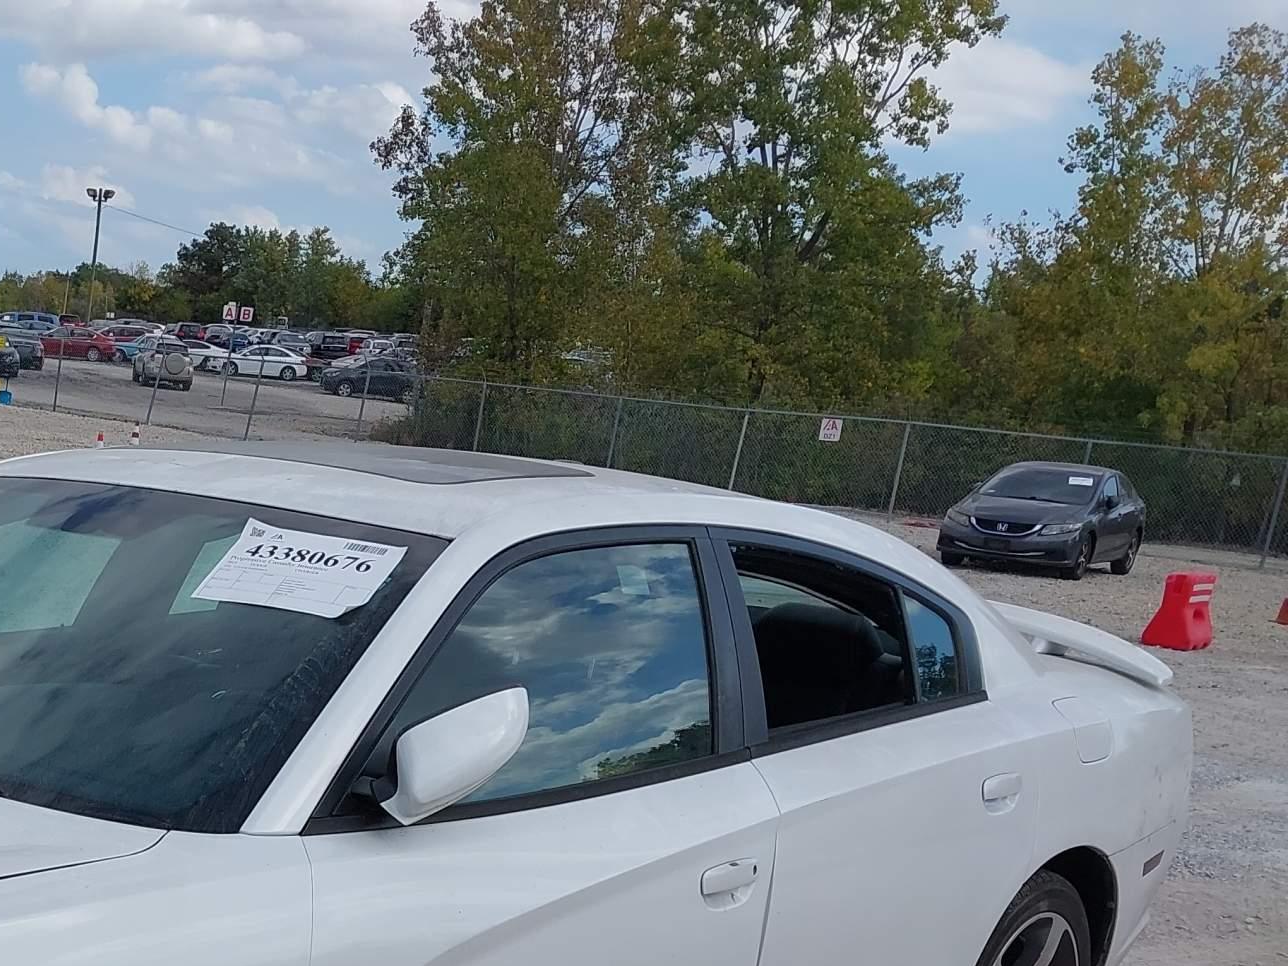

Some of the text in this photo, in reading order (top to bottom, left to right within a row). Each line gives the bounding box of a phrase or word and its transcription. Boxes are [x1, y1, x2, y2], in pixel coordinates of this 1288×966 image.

[224, 307, 251, 320] A B
[245, 543, 377, 573] 43380676
